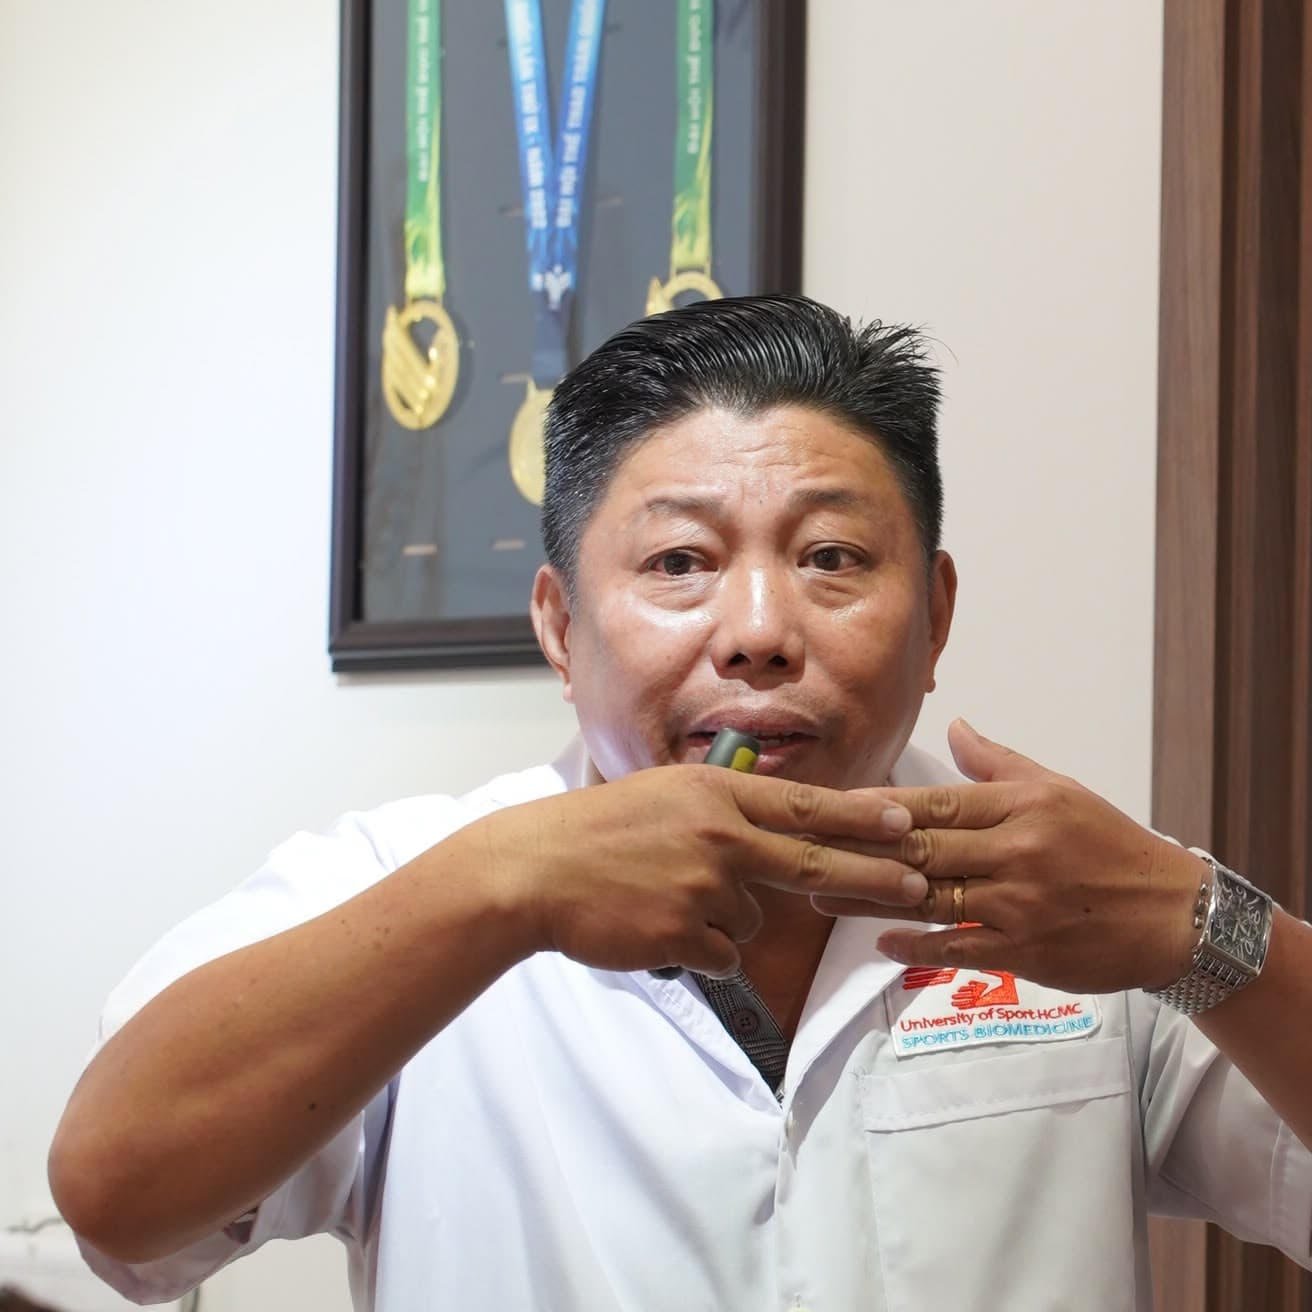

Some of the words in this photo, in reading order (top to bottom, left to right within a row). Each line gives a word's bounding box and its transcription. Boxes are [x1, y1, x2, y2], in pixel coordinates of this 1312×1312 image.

[901, 1012, 974, 1032] University
[978, 1009, 993, 1021] of
[999, 1008, 1036, 1023] Sport
[1036, 1003, 1083, 1019] HCMC
[902, 1028, 969, 1049] SPORTS
[974, 1015, 1095, 1038] BIOMEDICINE
